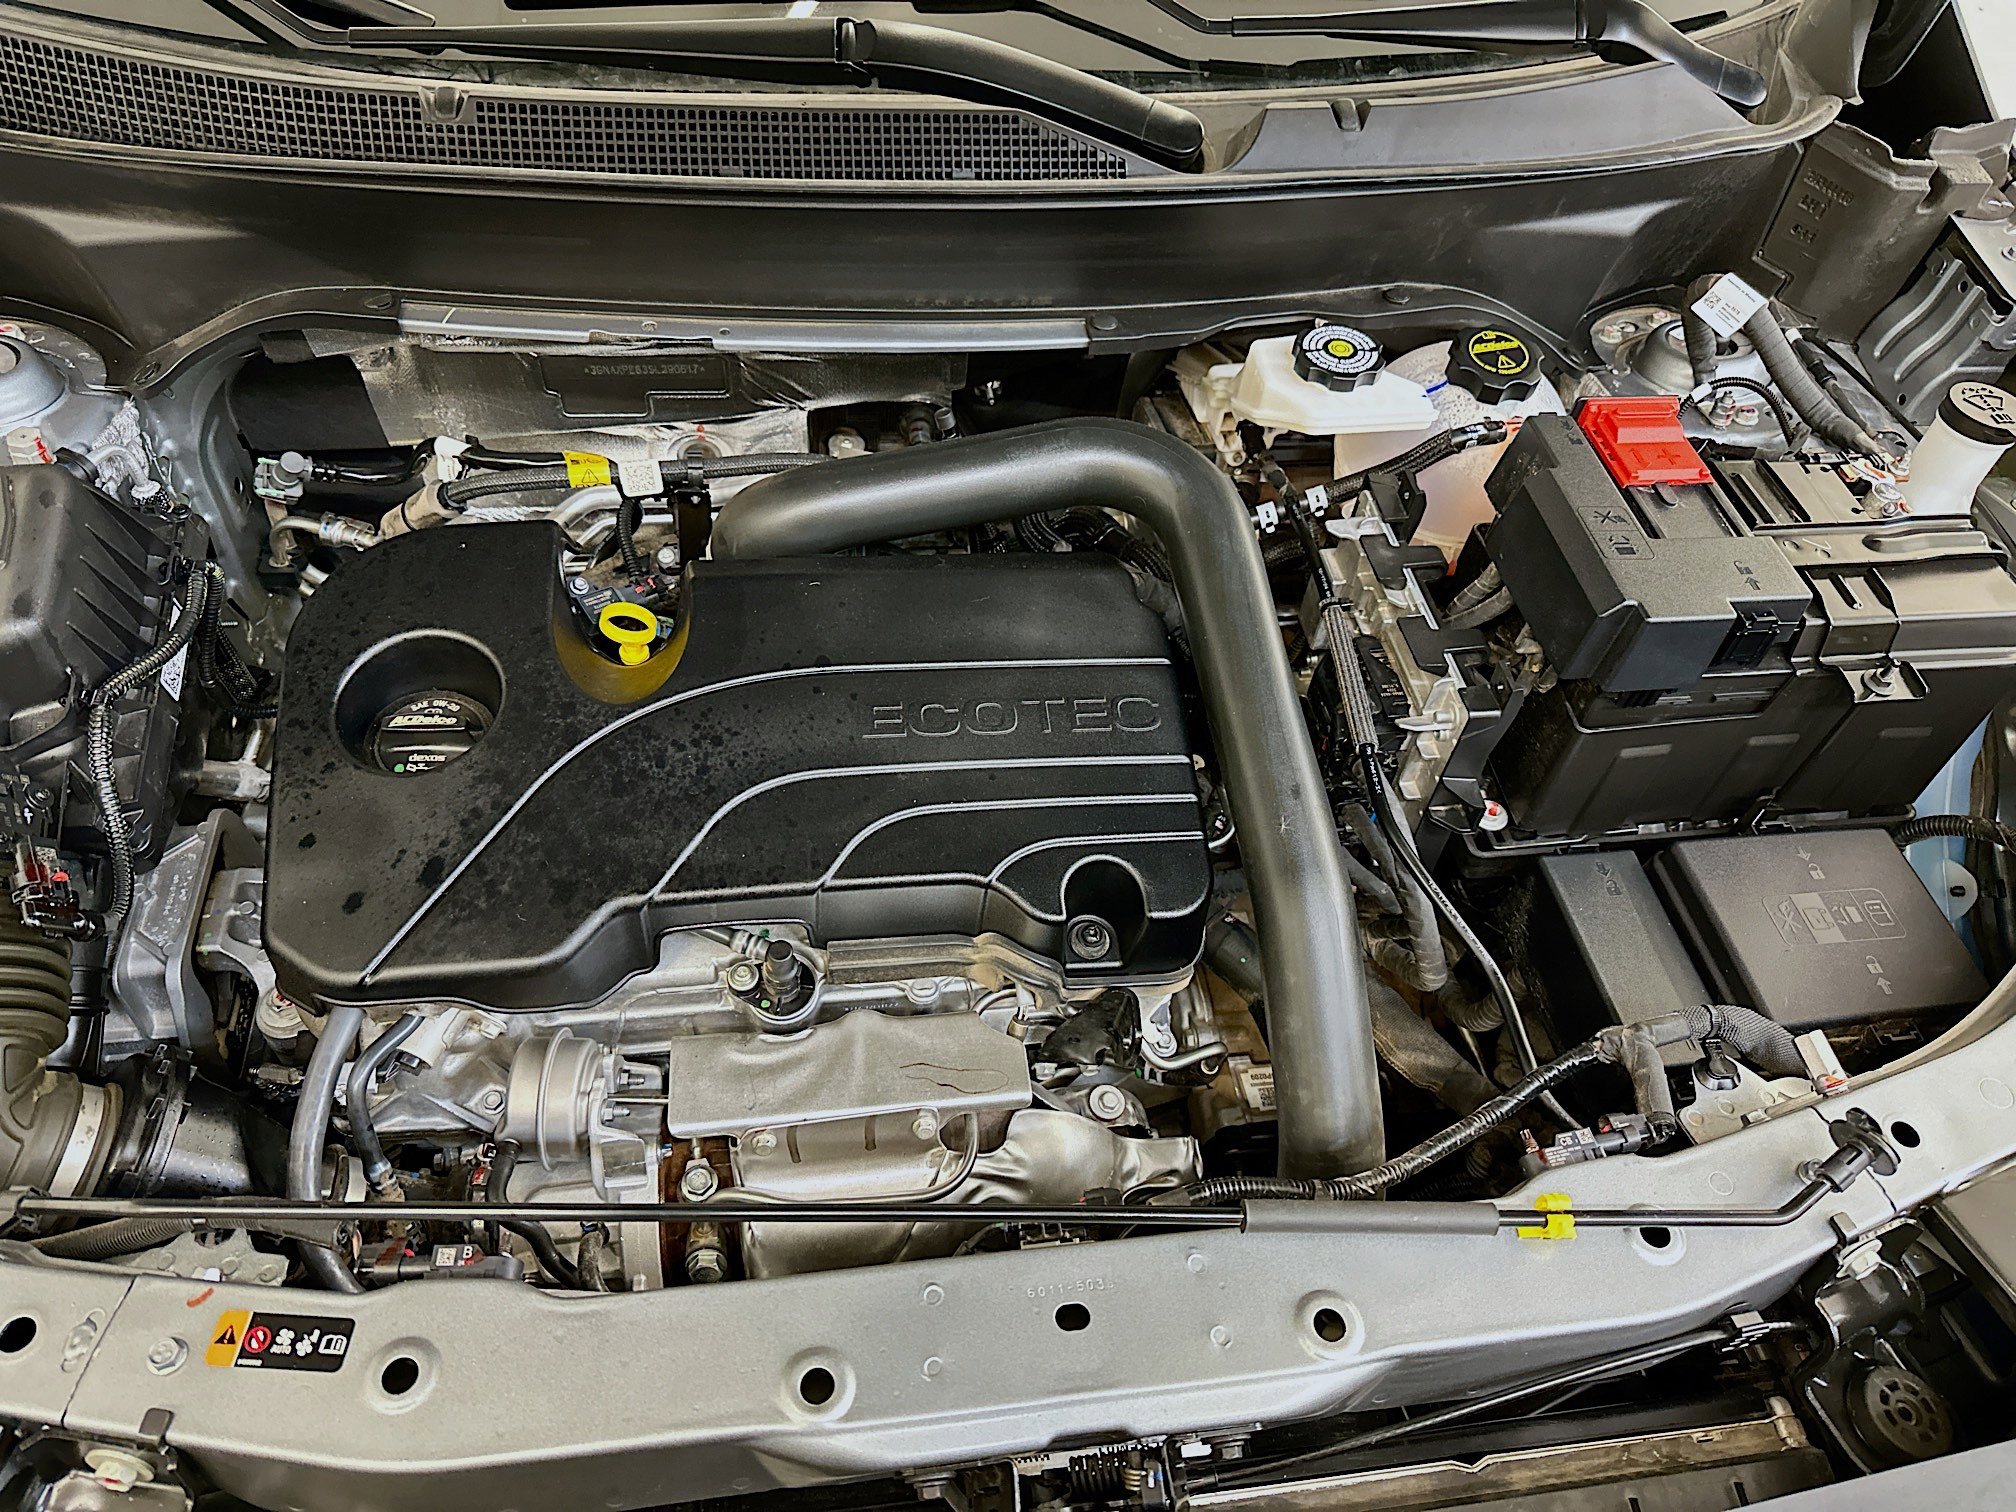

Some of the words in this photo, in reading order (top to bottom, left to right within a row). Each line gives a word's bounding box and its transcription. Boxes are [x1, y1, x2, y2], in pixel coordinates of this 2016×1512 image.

[411, 700, 430, 712] SAE
[432, 699, 461, 712] 0W-20
[388, 714, 459, 728] ACDelco
[862, 695, 1162, 739] ECOTEC
[408, 753, 447, 762] dexos
[1559, 1136, 1573, 1147] CB
[462, 1245, 473, 1259] B
[269, 1344, 292, 1355] AUTO
